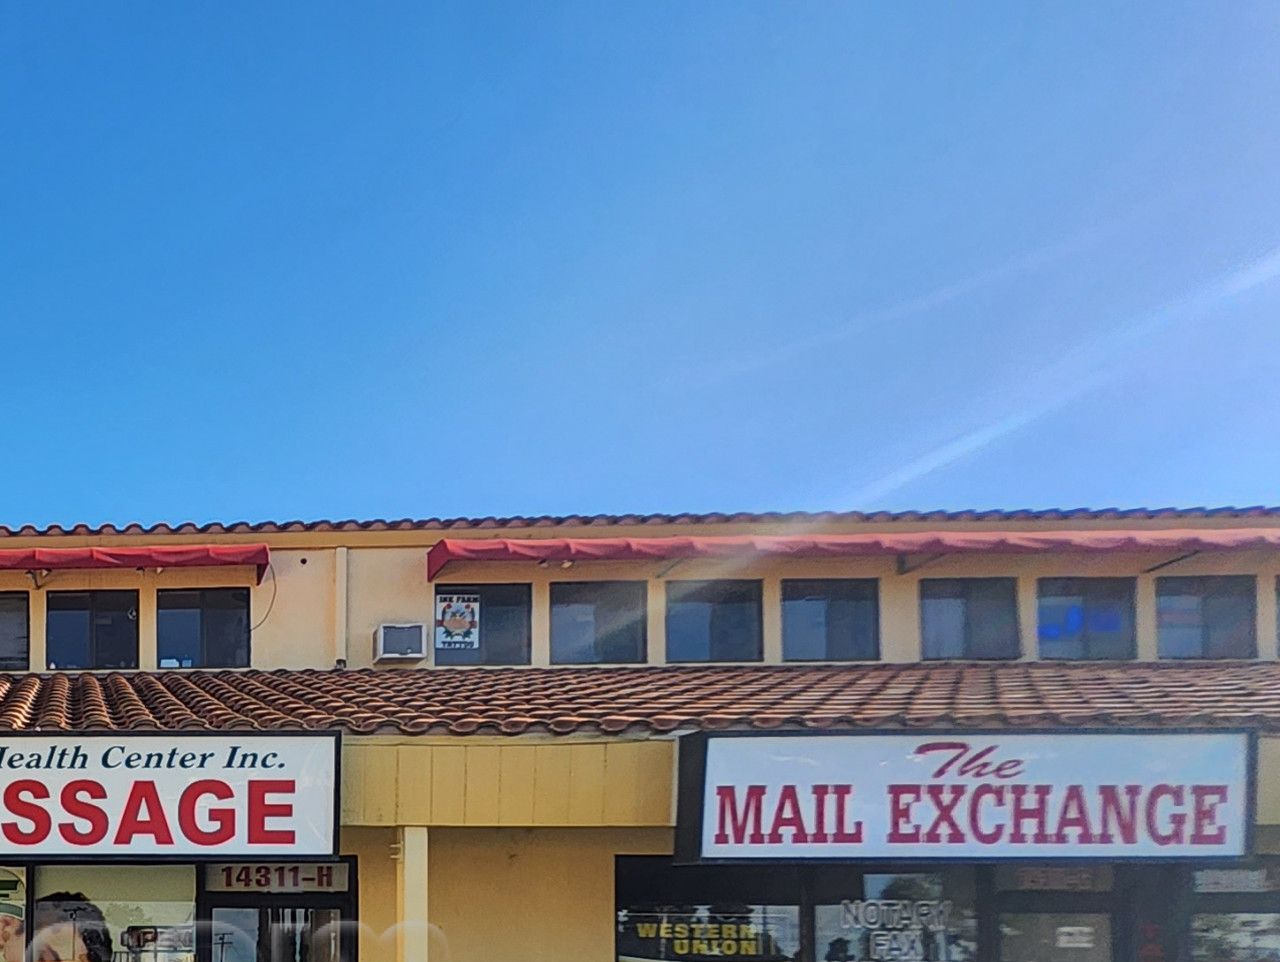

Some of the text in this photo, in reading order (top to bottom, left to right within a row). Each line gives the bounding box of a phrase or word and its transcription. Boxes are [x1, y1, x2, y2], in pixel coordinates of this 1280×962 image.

[101, 745, 215, 769] Center
[220, 745, 286, 769] Inc.
[914, 742, 1027, 779] The
[714, 784, 1228, 845] MAIL EXCHANGE
[221, 866, 333, 888] 14311-H
[841, 899, 950, 929] NOTARY
[636, 922, 757, 939] WESTERN
[674, 939, 757, 955] UNION
[871, 930, 926, 960] FAX
